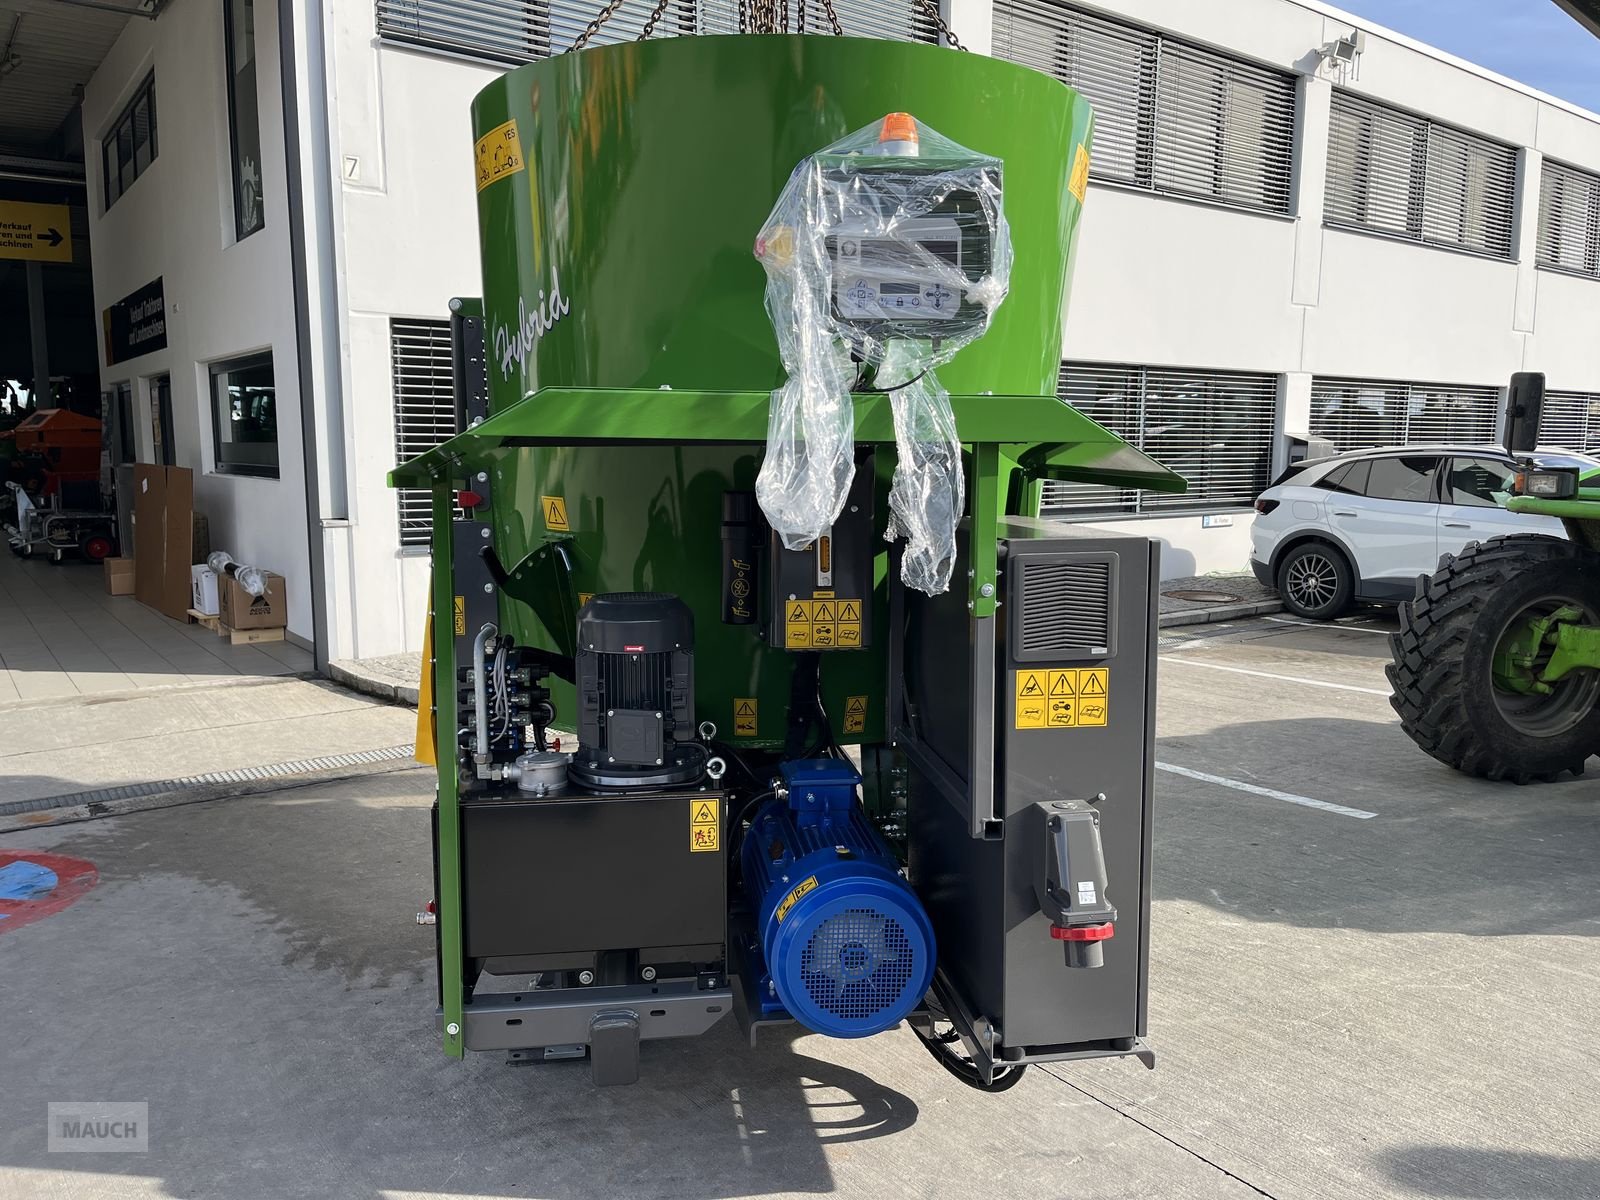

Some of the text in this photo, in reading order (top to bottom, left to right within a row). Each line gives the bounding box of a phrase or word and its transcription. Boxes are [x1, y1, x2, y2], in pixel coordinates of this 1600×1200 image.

[503, 128, 516, 141] YES
[345, 157, 358, 178] 7
[15, 232, 33, 240] und
[143, 297, 162, 317] Traktoren
[136, 319, 164, 343] Landmaschinen
[494, 265, 569, 382] Hybrid
